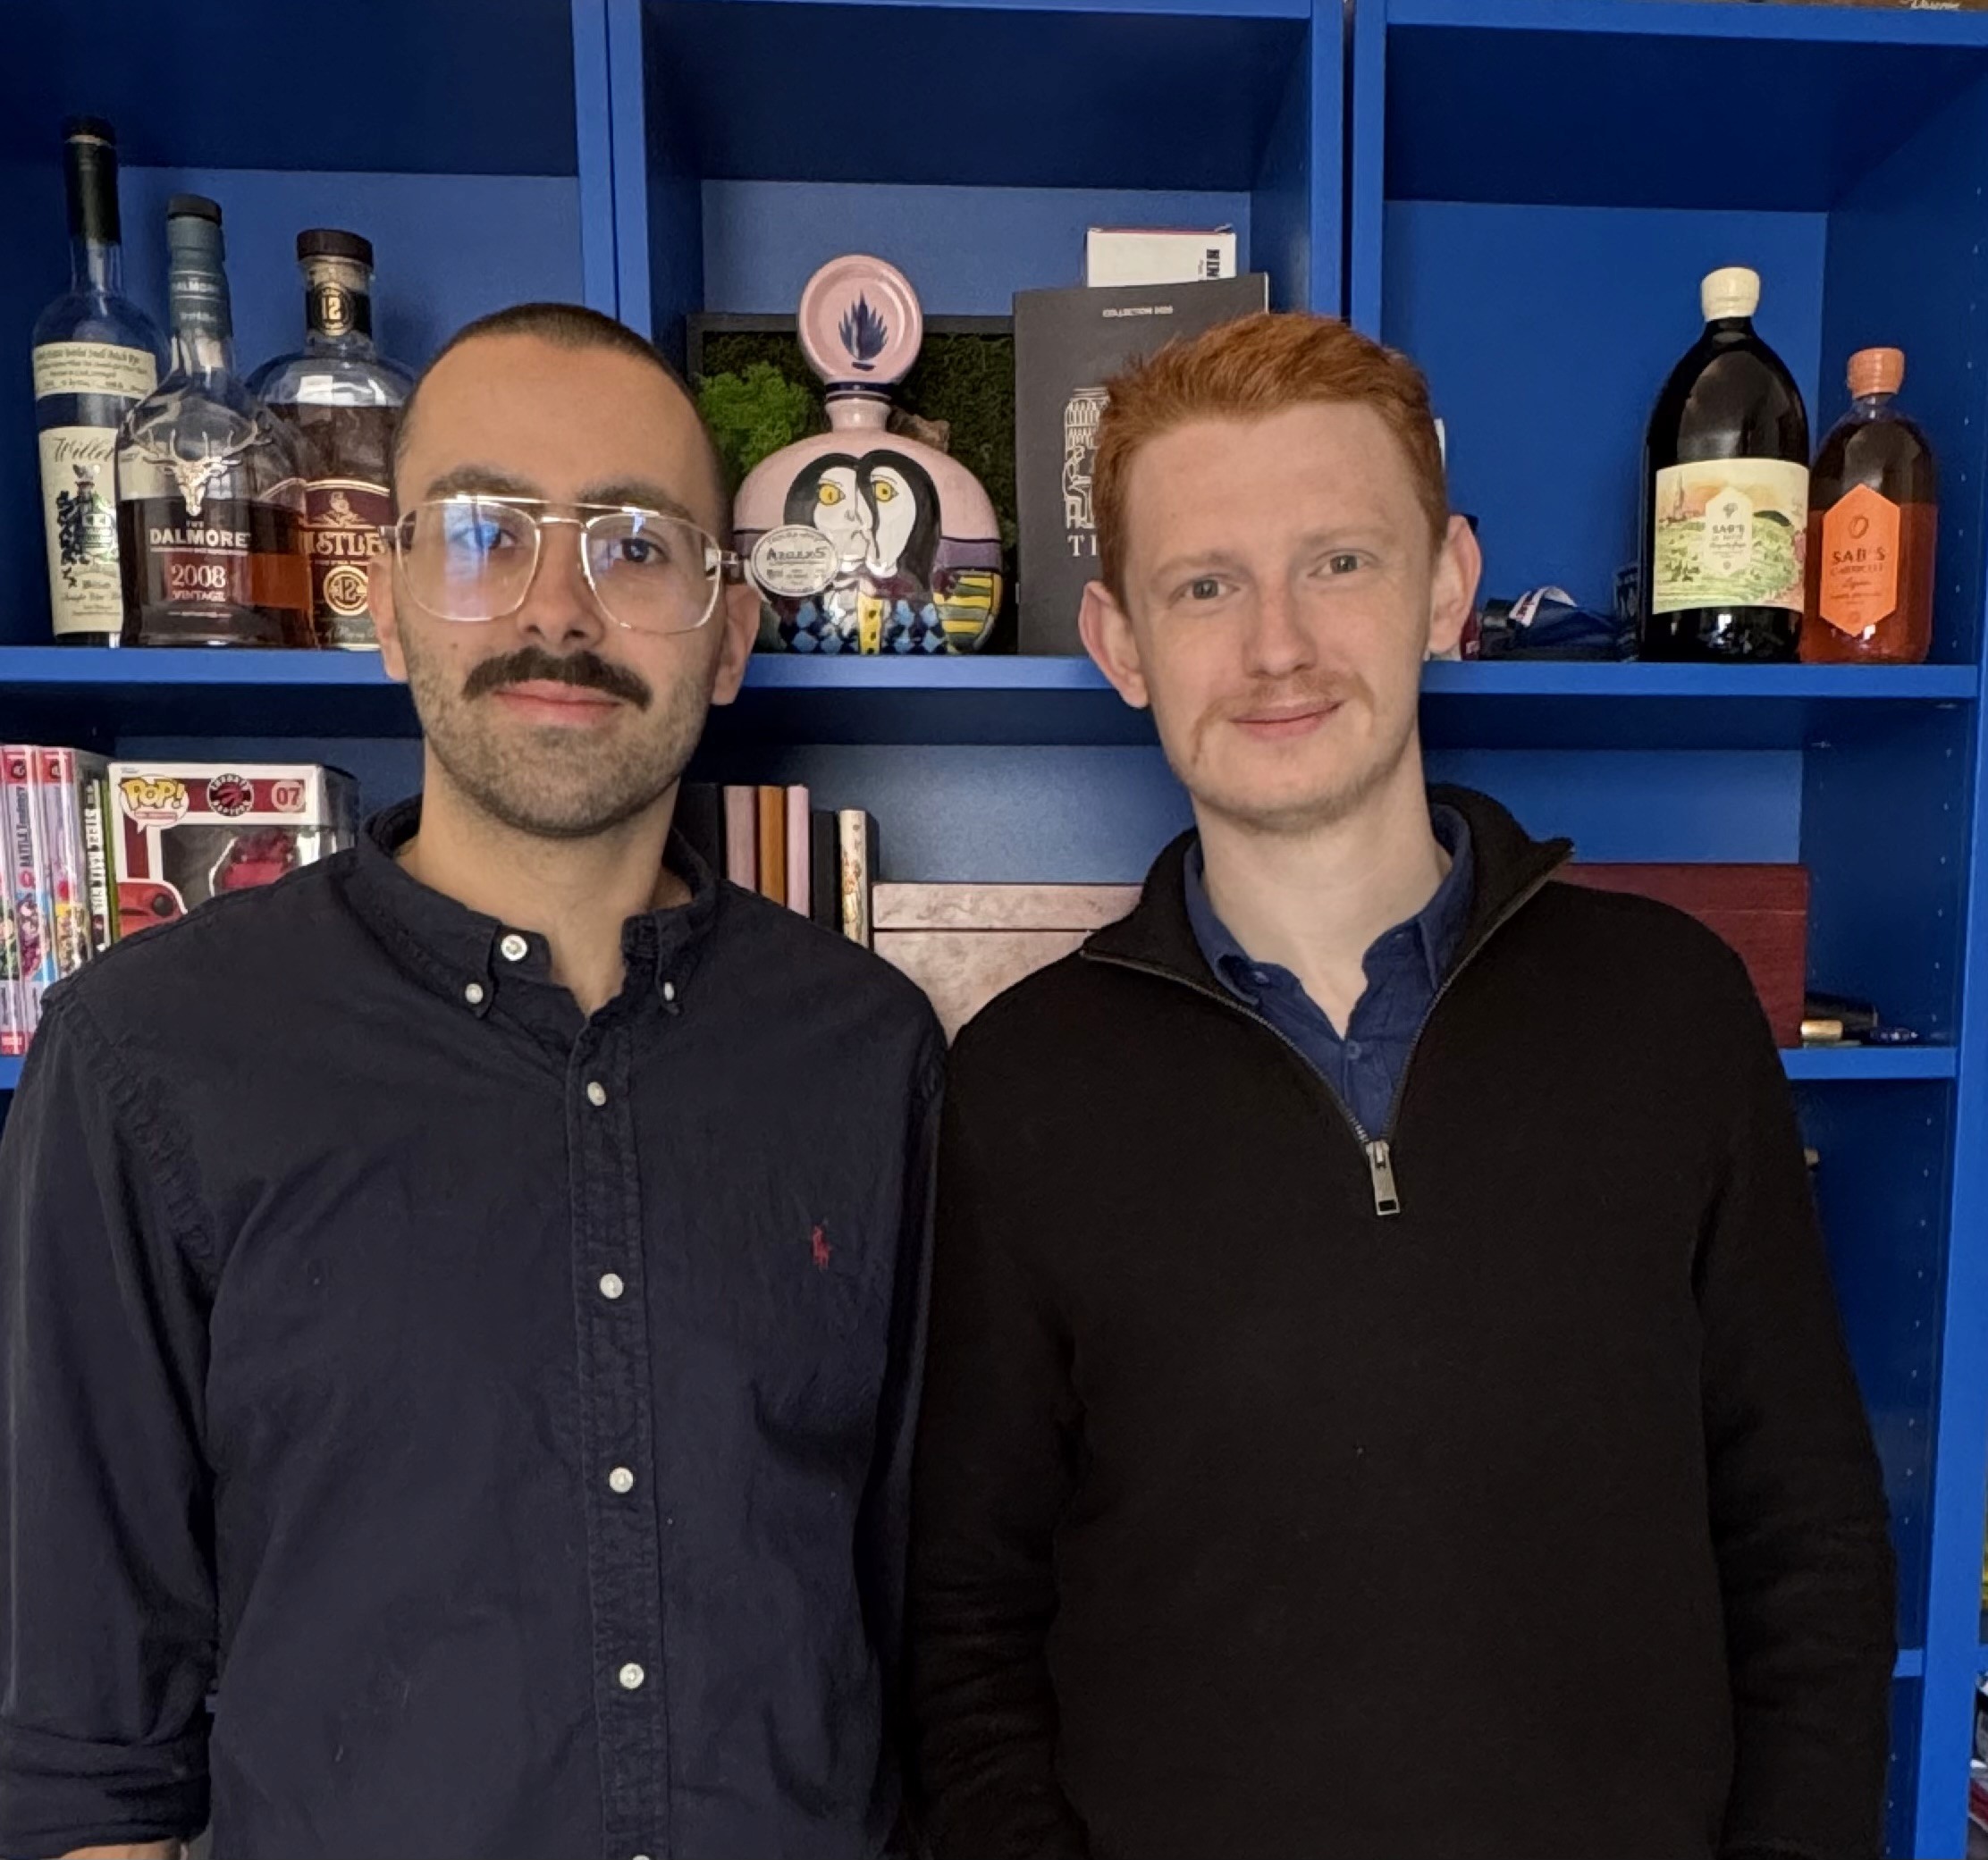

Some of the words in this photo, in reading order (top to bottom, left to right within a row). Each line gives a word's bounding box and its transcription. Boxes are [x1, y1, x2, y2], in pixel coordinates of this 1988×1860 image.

[149, 527, 249, 548] DALMORE
[171, 563, 227, 588] 2008
[120, 777, 186, 811] POP!
[276, 787, 301, 806] 07
